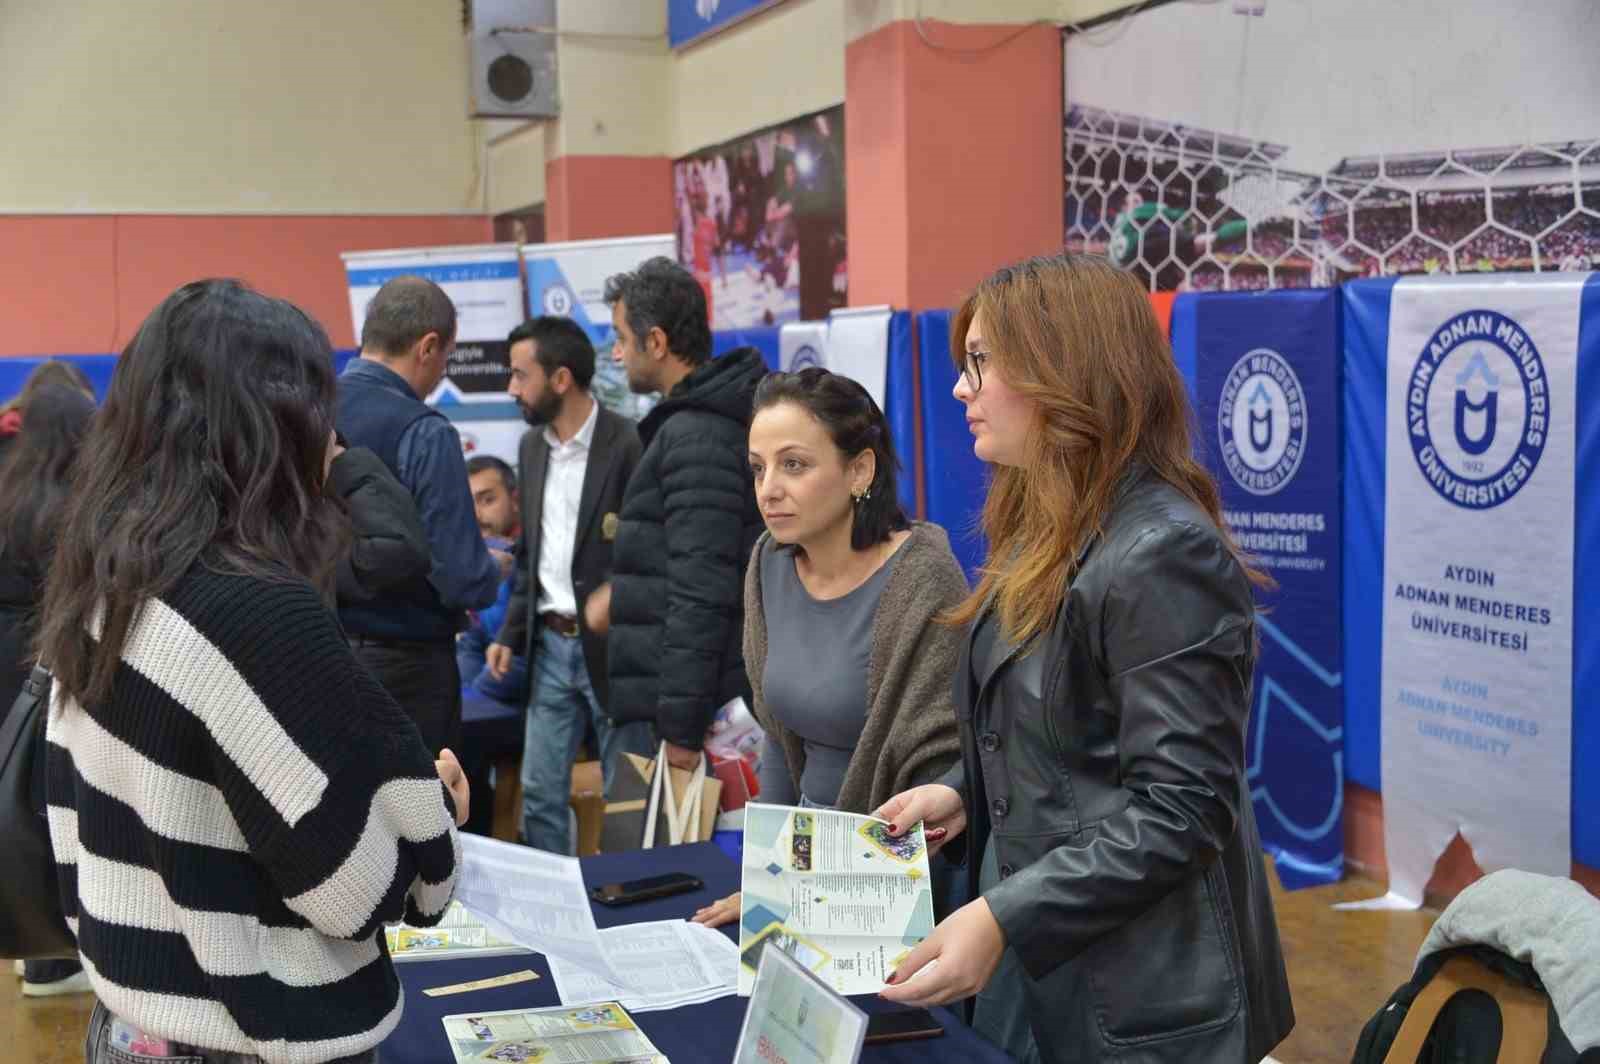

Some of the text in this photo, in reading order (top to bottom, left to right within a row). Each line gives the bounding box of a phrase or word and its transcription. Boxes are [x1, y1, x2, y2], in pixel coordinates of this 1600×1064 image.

[1222, 355, 1303, 429] ADNAN MENDERES
[1410, 315, 1546, 448] AYDIN ADNAN MENDERES
[1222, 510, 1325, 531] NAN MENDERES
[1444, 564, 1495, 587] AYDIN
[1395, 583, 1551, 626] ADNAN MENDERES
[1411, 610, 1528, 652] ÜNİVERSİTESİ
[1440, 675, 1489, 699] AYDIN
[1397, 687, 1540, 737] ADNAN MENDERES
[1417, 719, 1512, 756] UNIVERSITY
